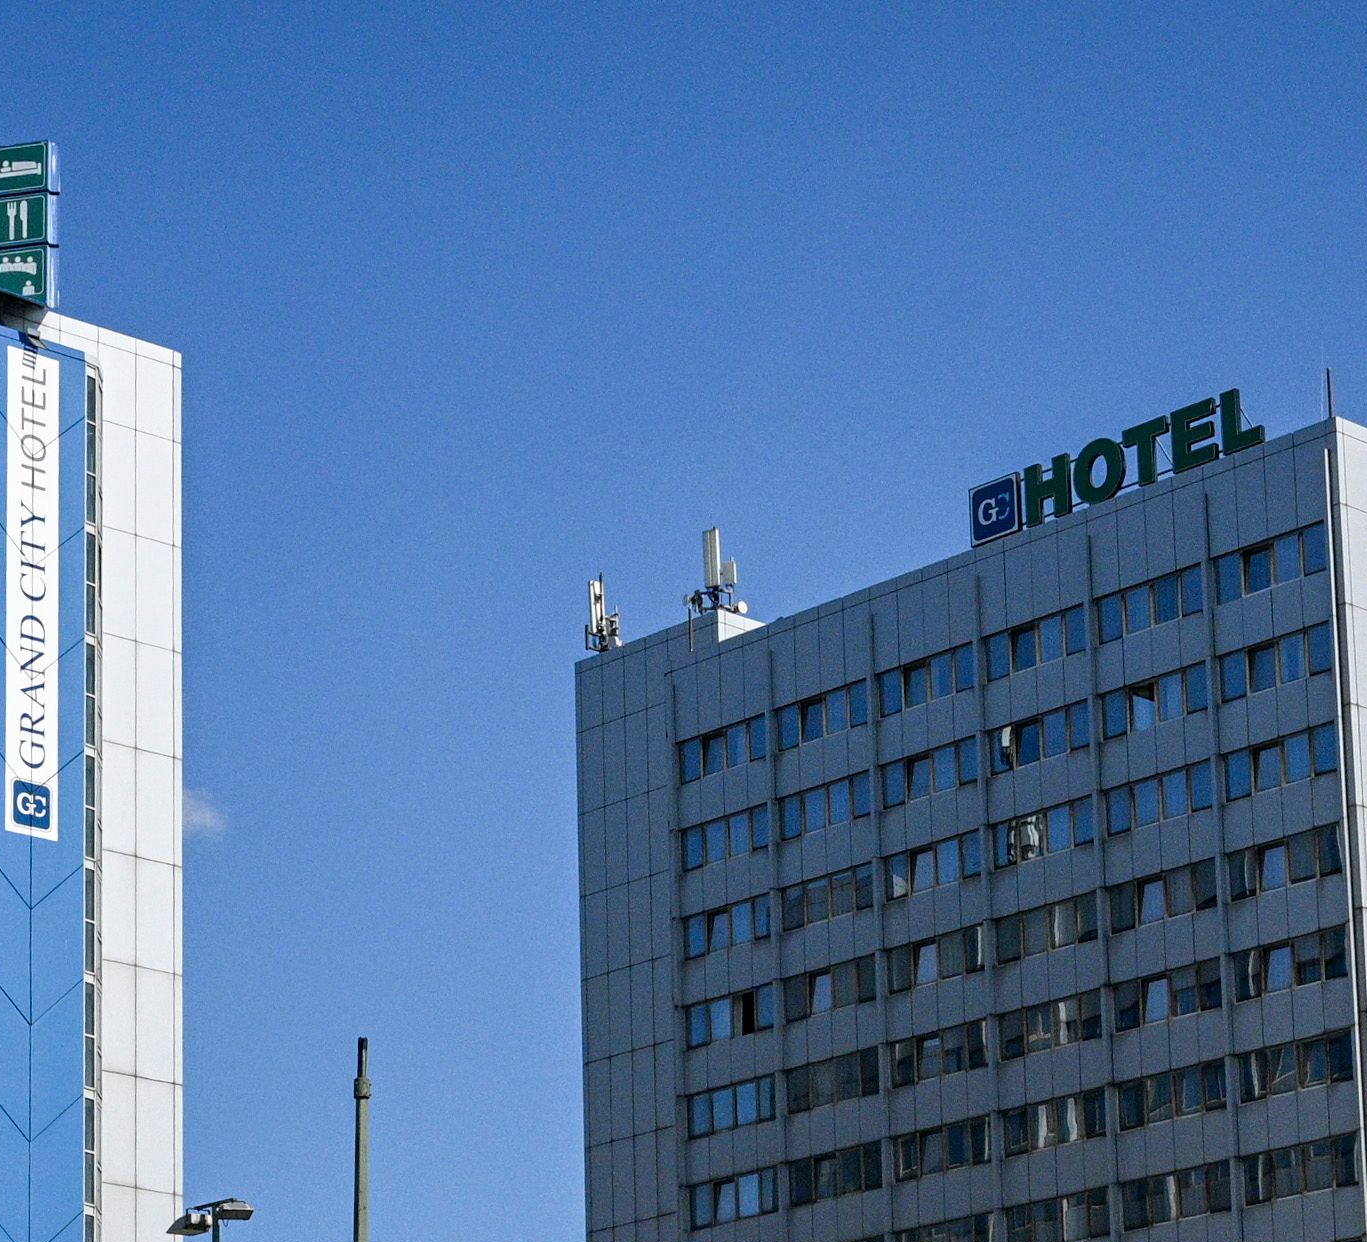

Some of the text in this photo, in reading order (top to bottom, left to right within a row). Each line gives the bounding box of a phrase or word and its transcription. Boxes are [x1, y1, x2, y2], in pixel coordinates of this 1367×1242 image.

[21, 368, 46, 492] HOTEL
[1024, 388, 1265, 528] HOTEL
[20, 500, 46, 602] CITY
[19, 614, 46, 769] GRAND
